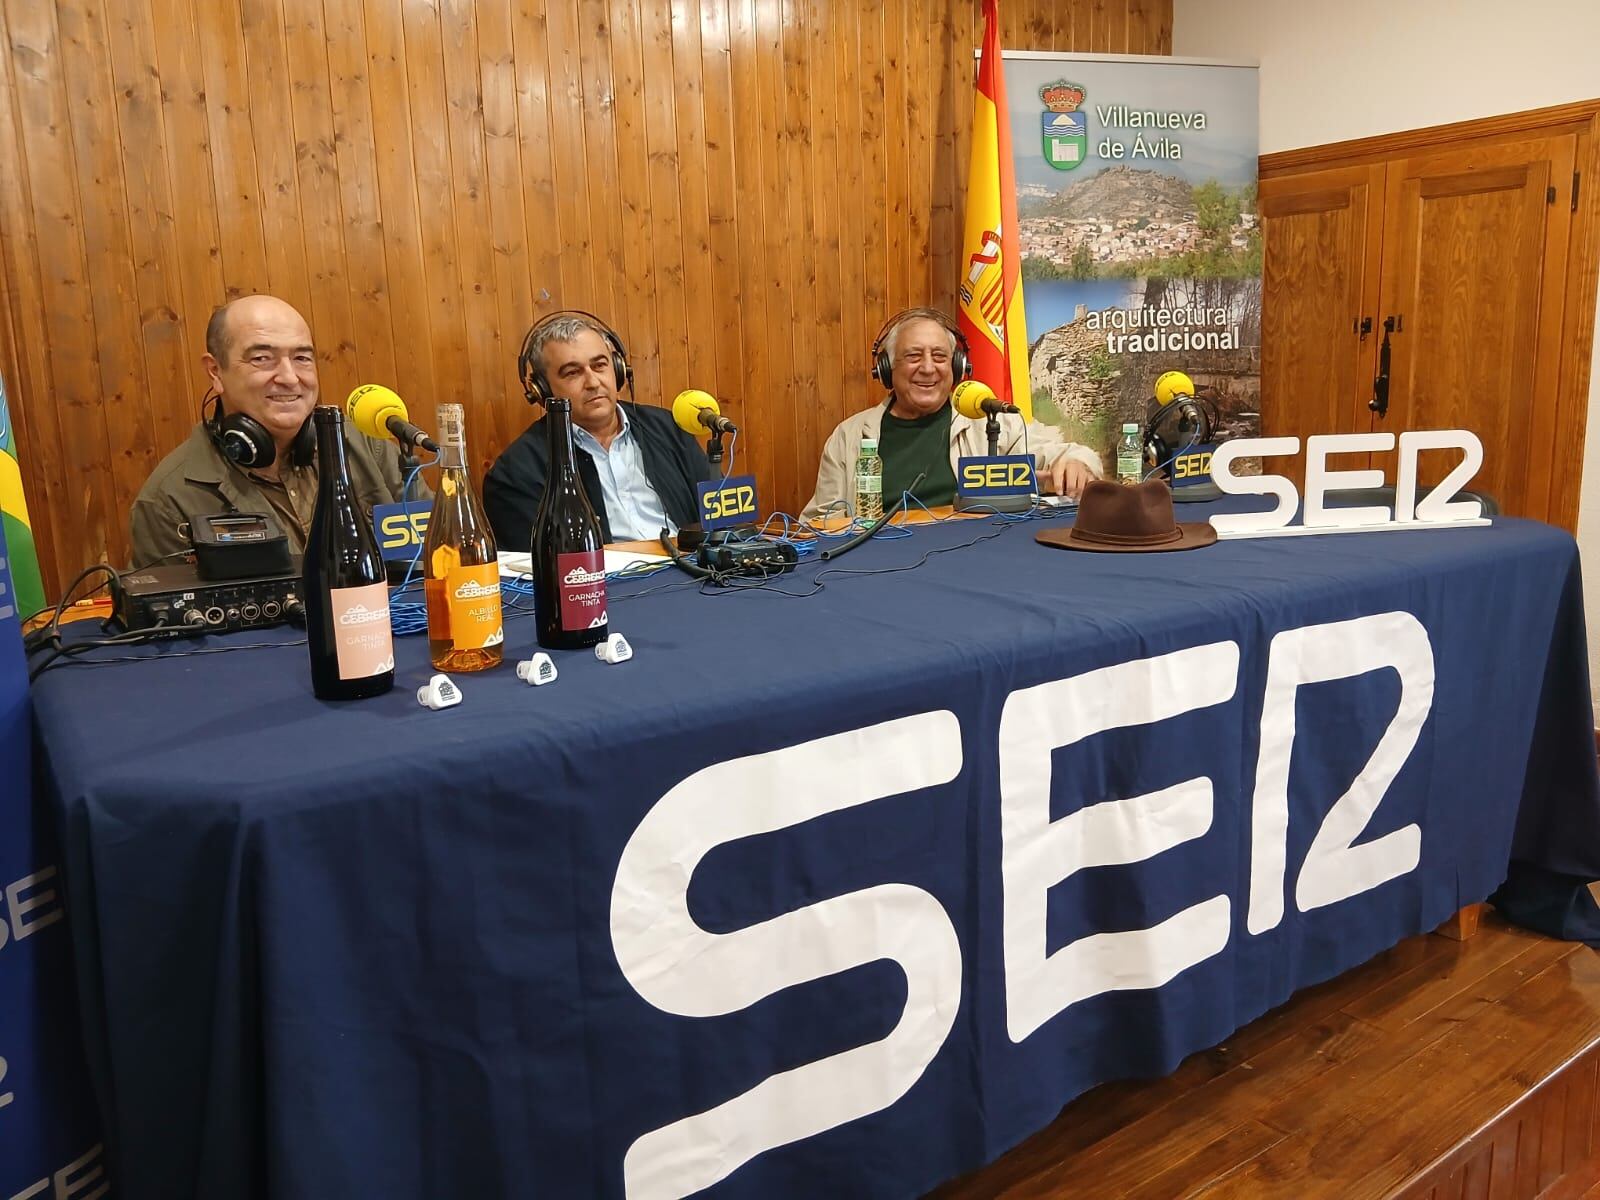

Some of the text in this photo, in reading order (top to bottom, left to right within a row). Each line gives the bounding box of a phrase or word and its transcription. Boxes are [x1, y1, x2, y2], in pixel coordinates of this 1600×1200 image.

[1096, 105, 1206, 129] Villanueva
[1098, 132, 1182, 159] de Ávila
[1086, 303, 1228, 334] arquitectura
[1106, 326, 1240, 354] tradicional
[963, 463, 1031, 488] SER
[1174, 452, 1213, 479] SER
[1209, 429, 1484, 529] SER
[703, 485, 756, 520] SER
[580, 599, 601, 607] TINTA
[609, 610, 1436, 1200] SER
